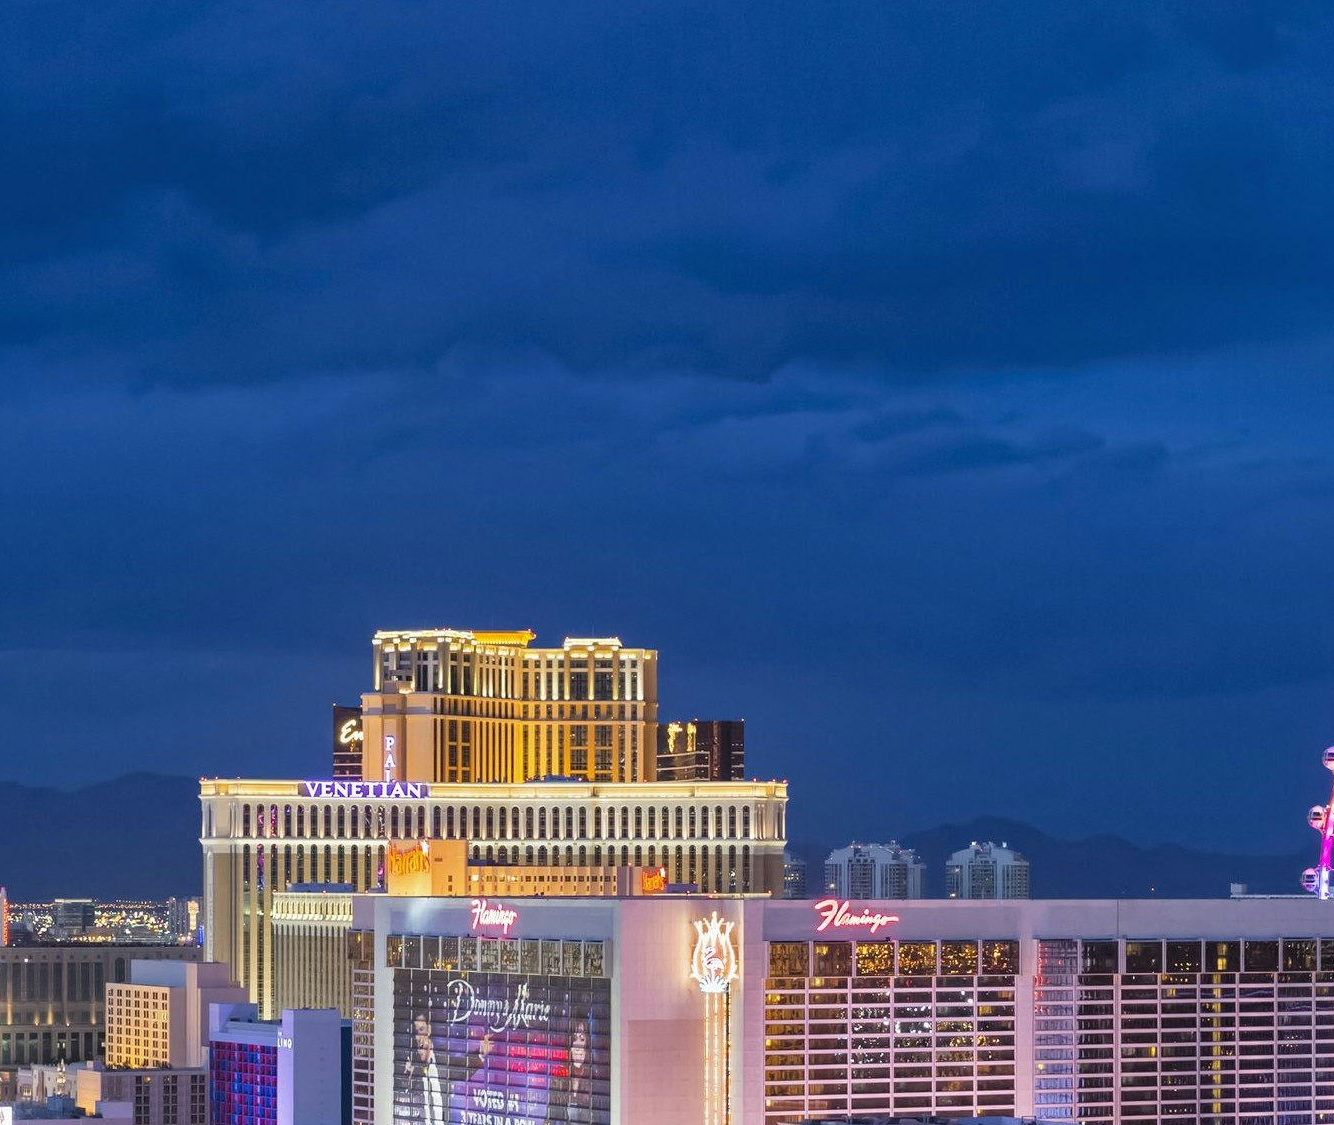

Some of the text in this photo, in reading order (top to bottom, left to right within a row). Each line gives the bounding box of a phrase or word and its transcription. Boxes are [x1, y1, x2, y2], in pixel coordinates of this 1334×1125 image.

[304, 781, 423, 799] VENETIAN
[471, 898, 518, 935] Flamingo
[814, 899, 899, 933] Flamingo
[277, 1038, 292, 1049] LINQ
